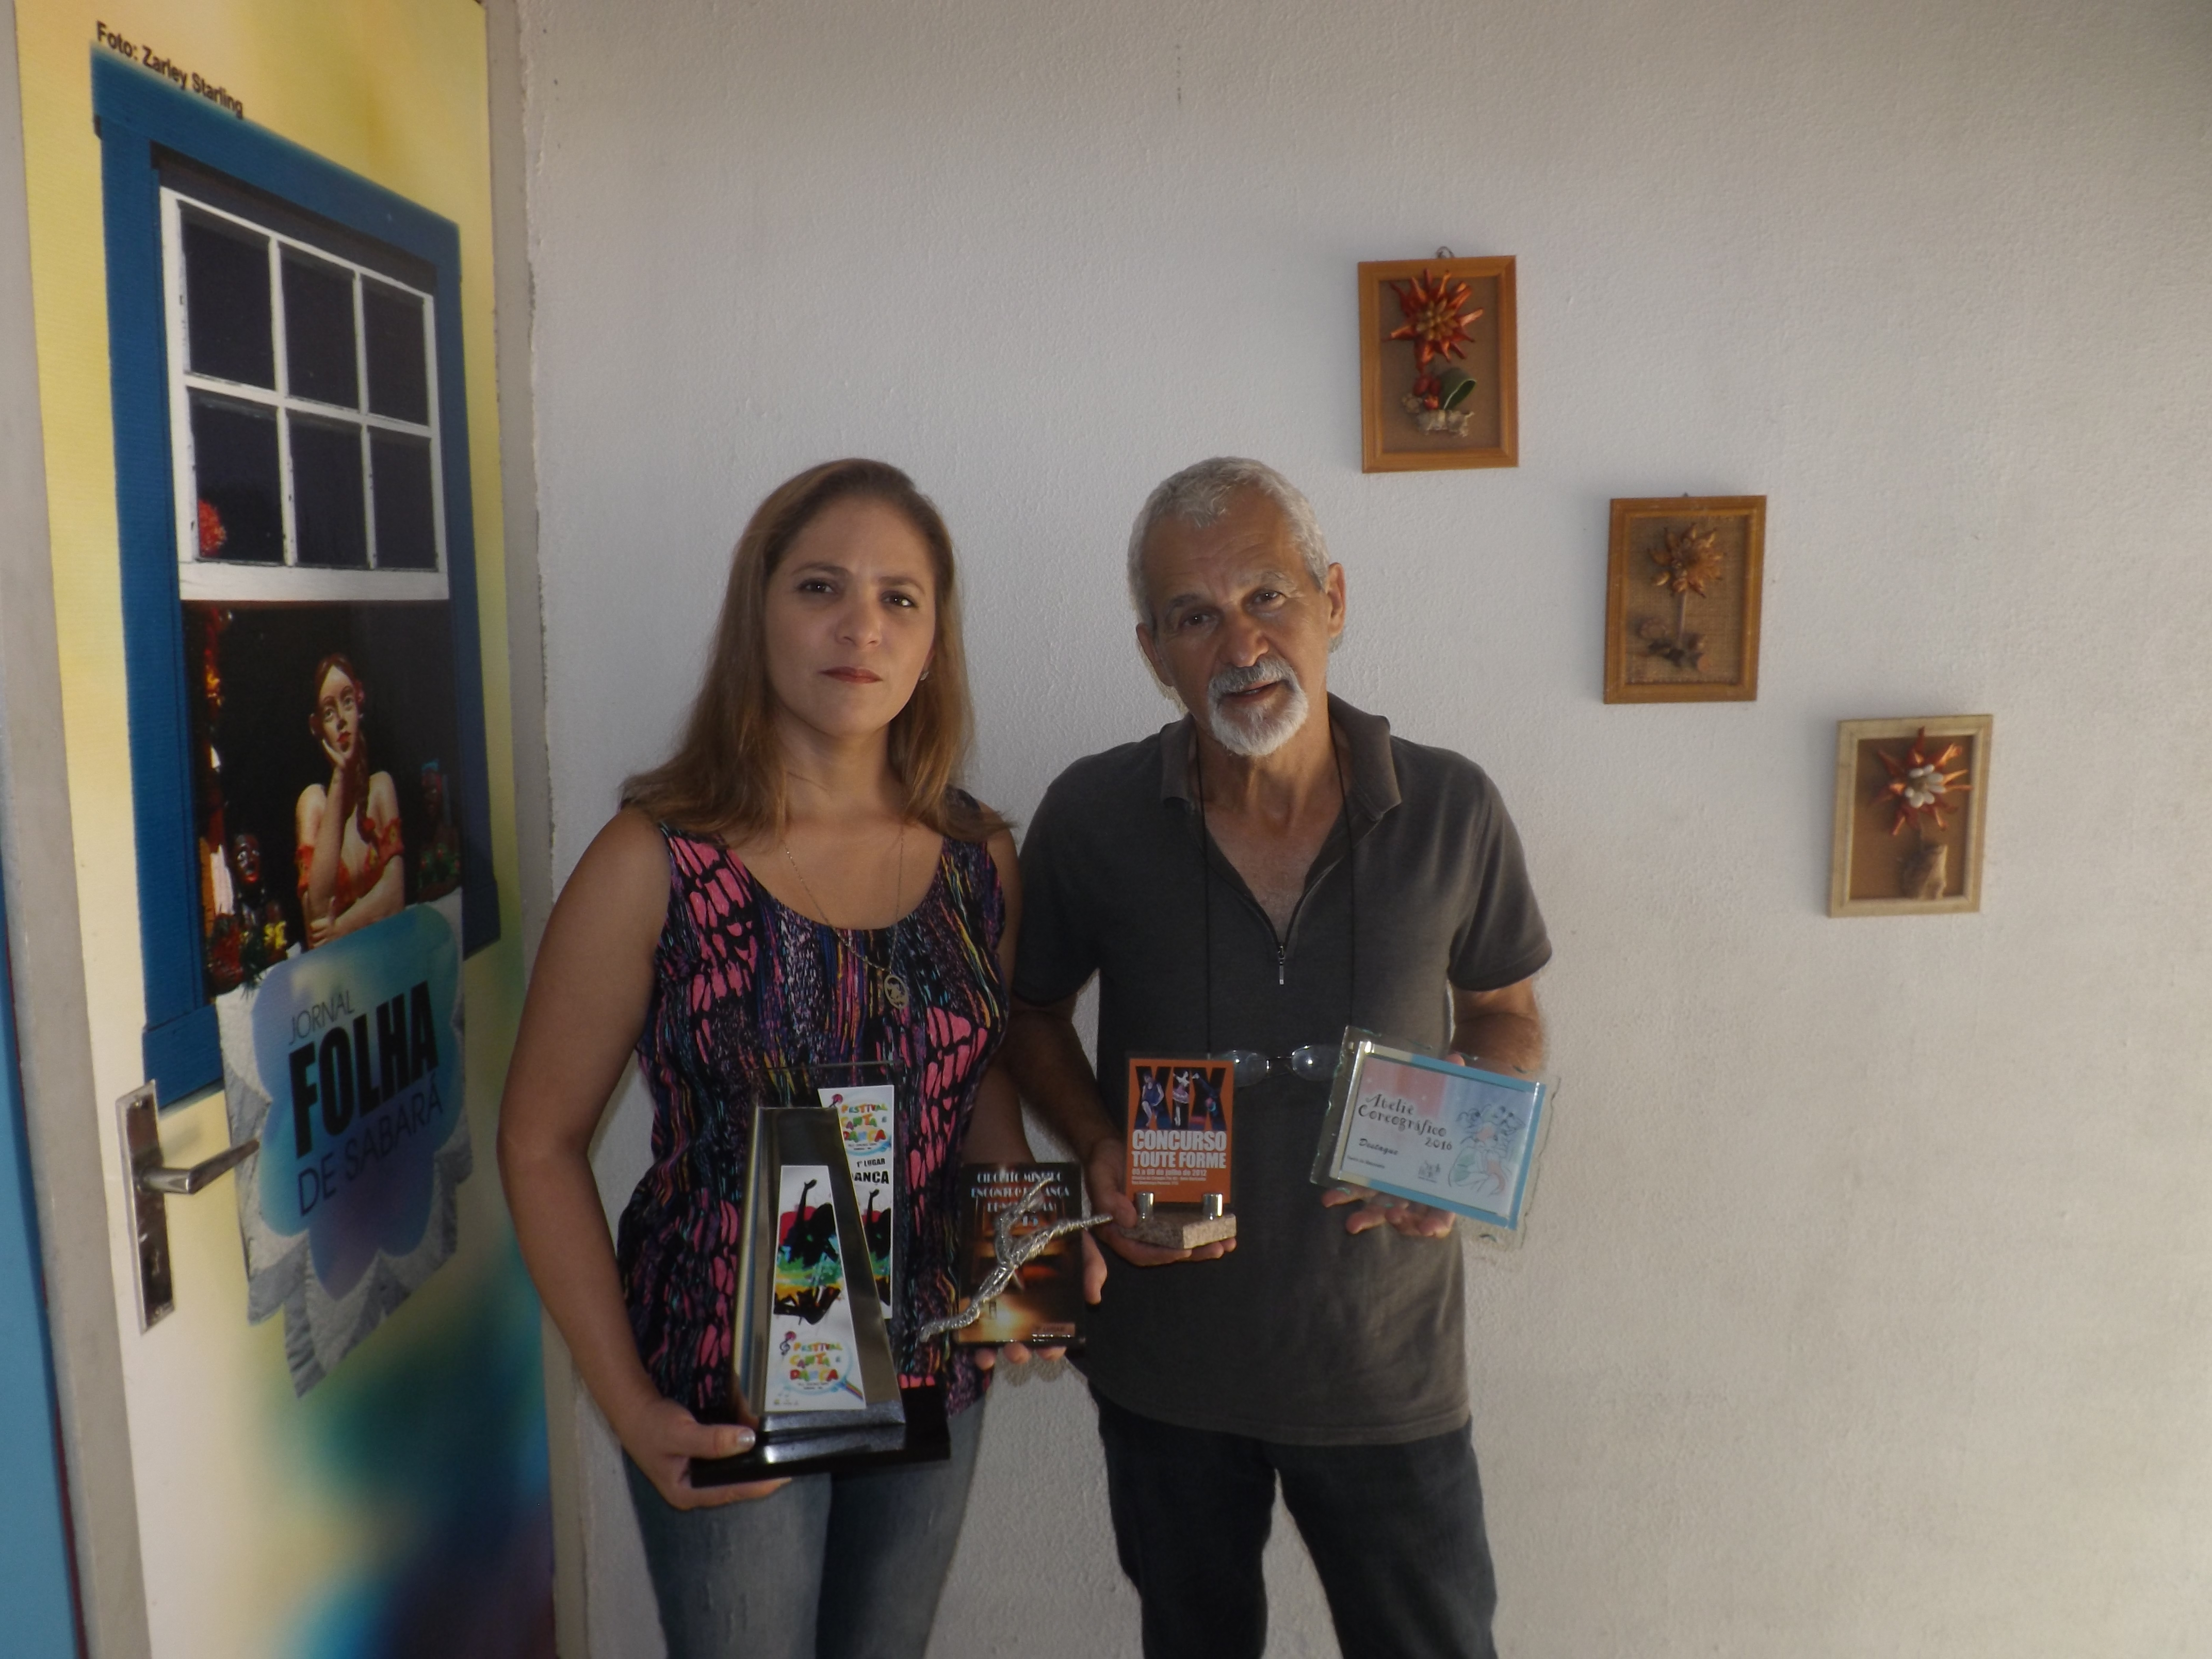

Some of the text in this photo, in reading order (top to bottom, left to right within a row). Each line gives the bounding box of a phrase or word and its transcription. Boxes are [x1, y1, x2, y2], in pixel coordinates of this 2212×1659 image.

[96, 20, 243, 120] Foto: Zarley Starling
[288, 989, 355, 1046] JORNAL
[288, 980, 438, 1160] FOLHA
[841, 1103, 888, 1114] FESTIVAL
[840, 1113, 877, 1131] CANTA
[298, 1071, 444, 1217] DE SABARÁ
[1132, 1129, 1227, 1152] CONCURSO
[1358, 1137, 1399, 1156] Destaque
[1424, 1136, 1453, 1151] 2016
[864, 1158, 886, 1167] LUGAR
[1131, 1150, 1227, 1169] TOUTE FORME
[852, 1170, 890, 1185] ANÇA
[793, 1342, 843, 1352] FESTIVAL
[789, 1352, 831, 1369] CANTA
